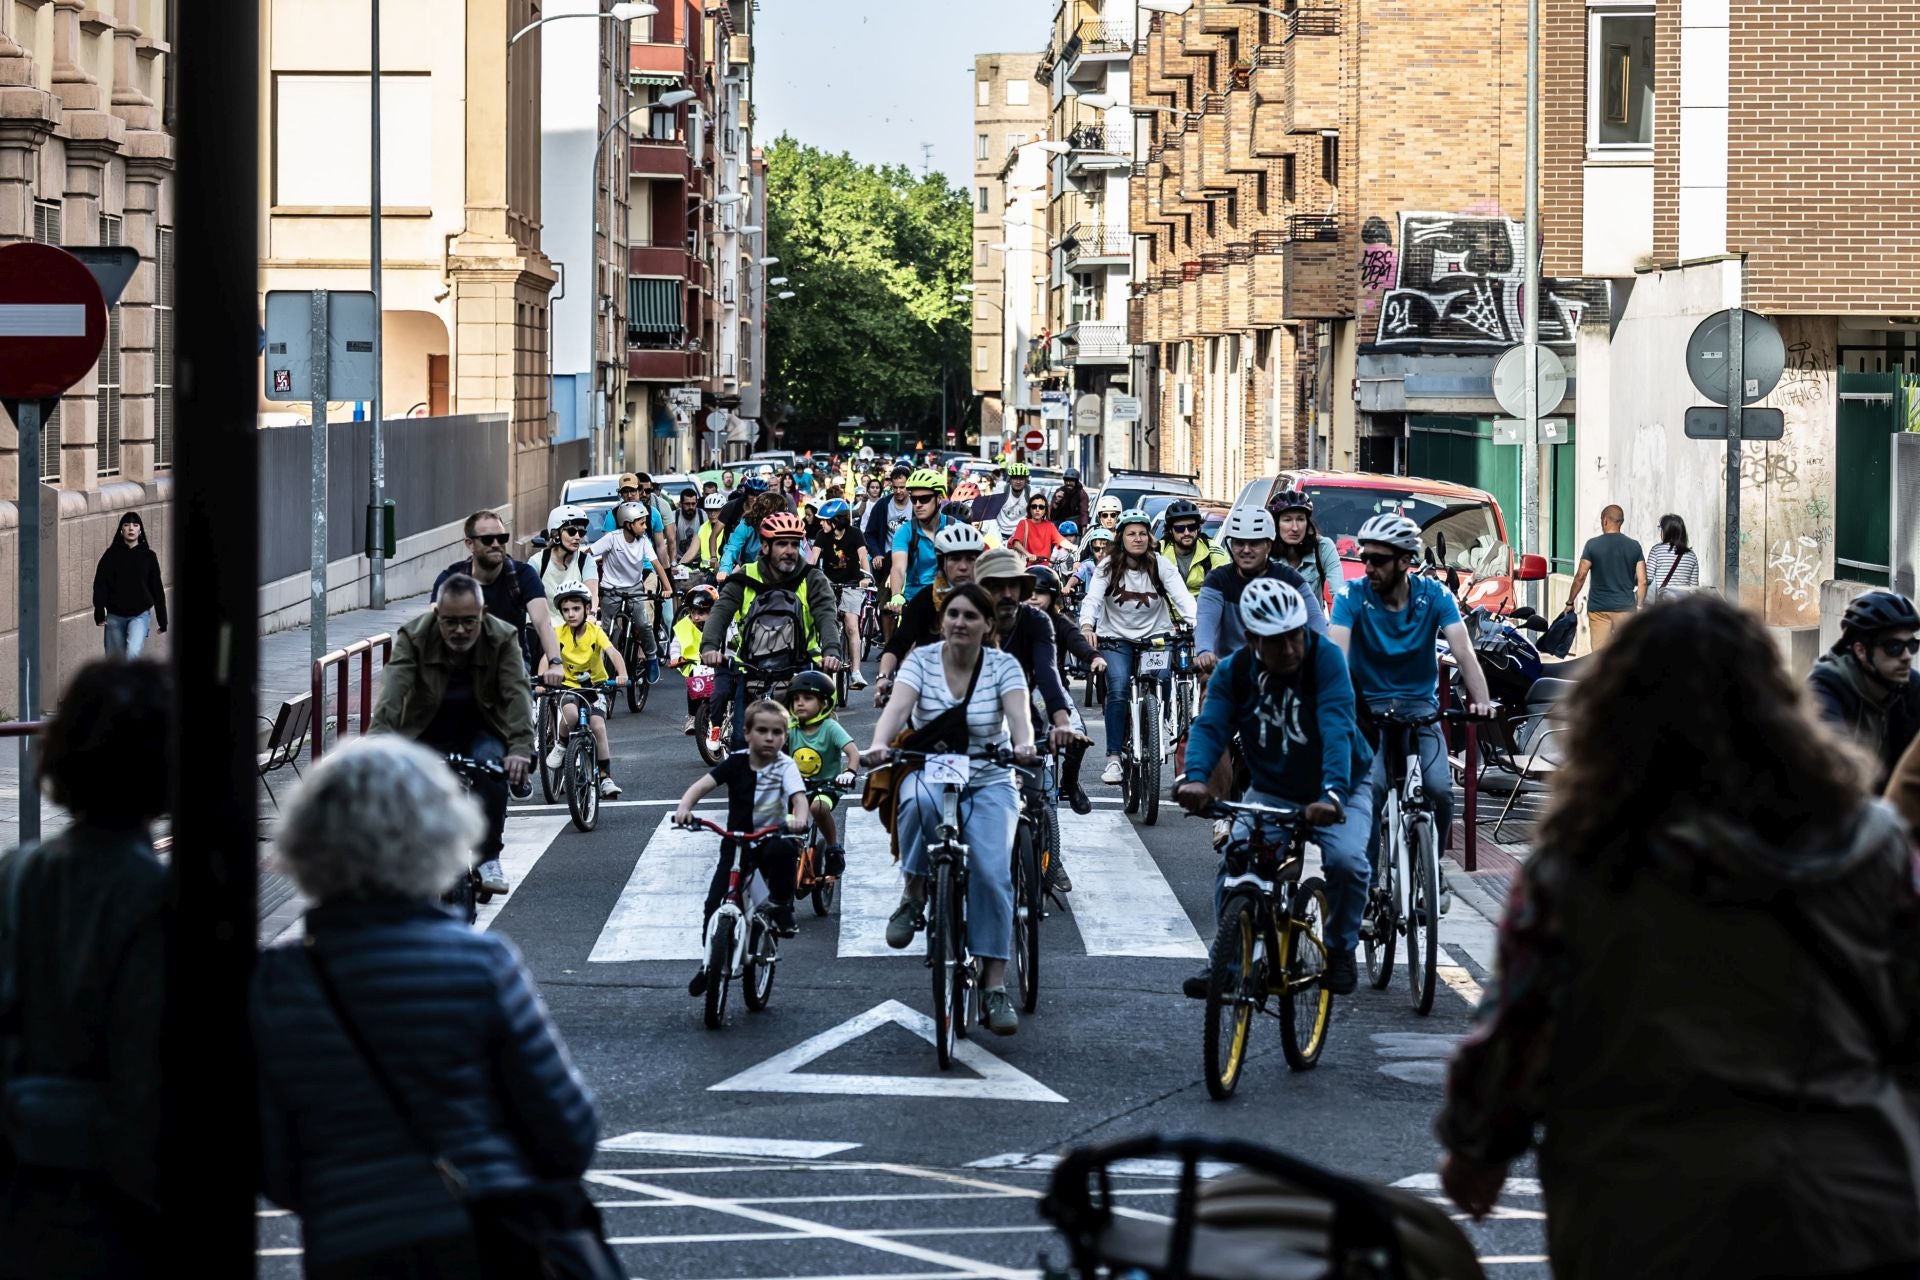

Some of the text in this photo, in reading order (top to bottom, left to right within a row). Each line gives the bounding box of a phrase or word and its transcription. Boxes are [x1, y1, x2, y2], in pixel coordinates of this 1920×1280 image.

[1362, 249, 1393, 265] MRC
[1361, 263, 1392, 282] DPM
[1387, 299, 1417, 333] 21
[1253, 687, 1308, 755] NY
